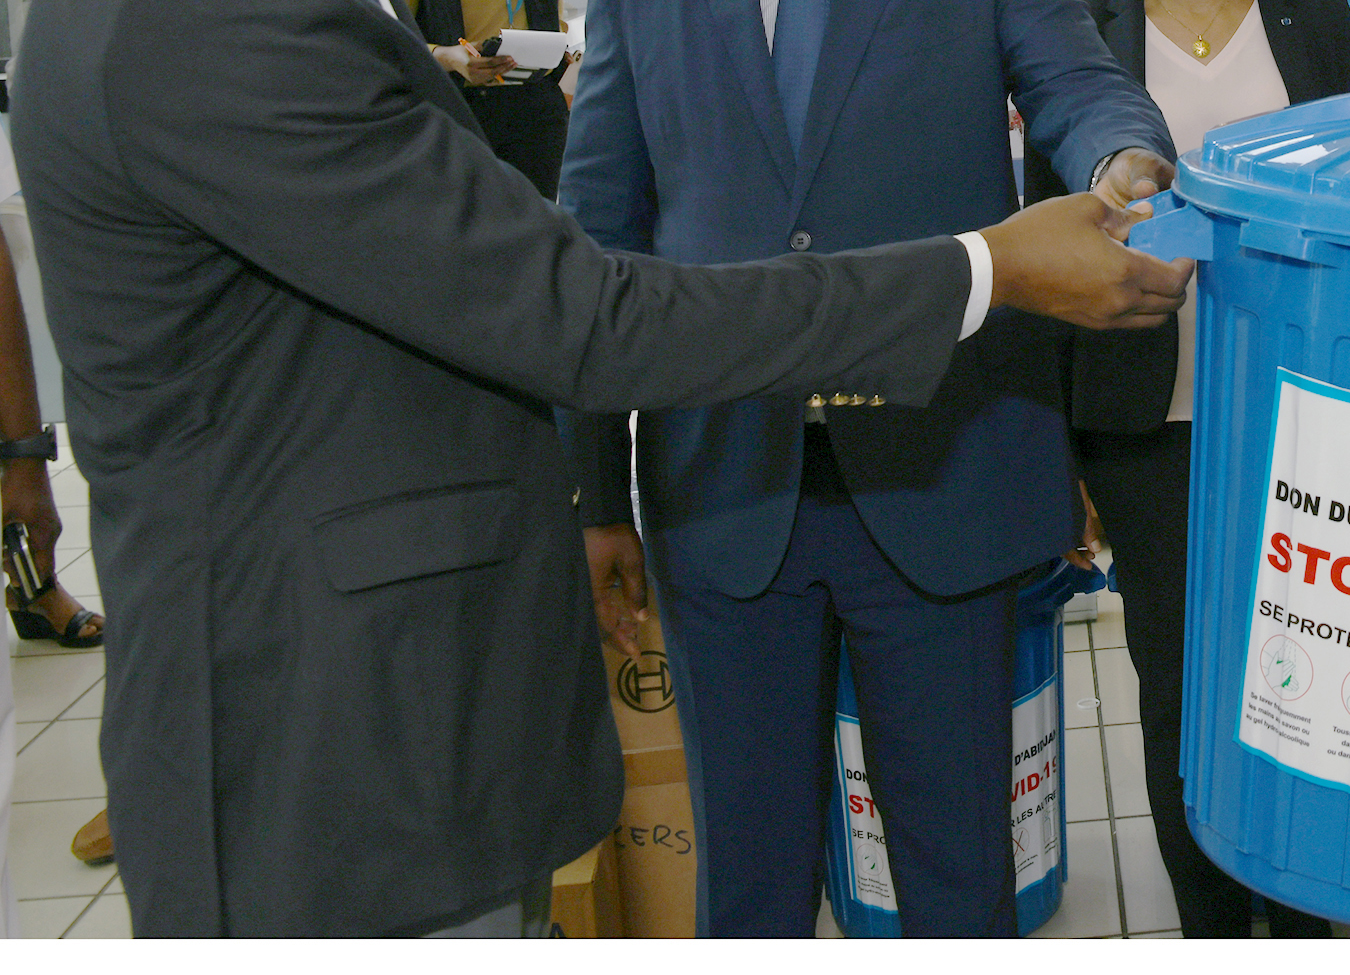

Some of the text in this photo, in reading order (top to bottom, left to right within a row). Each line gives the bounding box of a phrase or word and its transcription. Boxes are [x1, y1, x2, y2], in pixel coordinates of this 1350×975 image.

[1275, 479, 1321, 517] DON
[1259, 600, 1284, 623] SE
[1259, 695, 1273, 707] laver
[1258, 707, 1275, 719] mains
[1282, 720, 1300, 732] savon
[1016, 807, 1033, 825] LES
